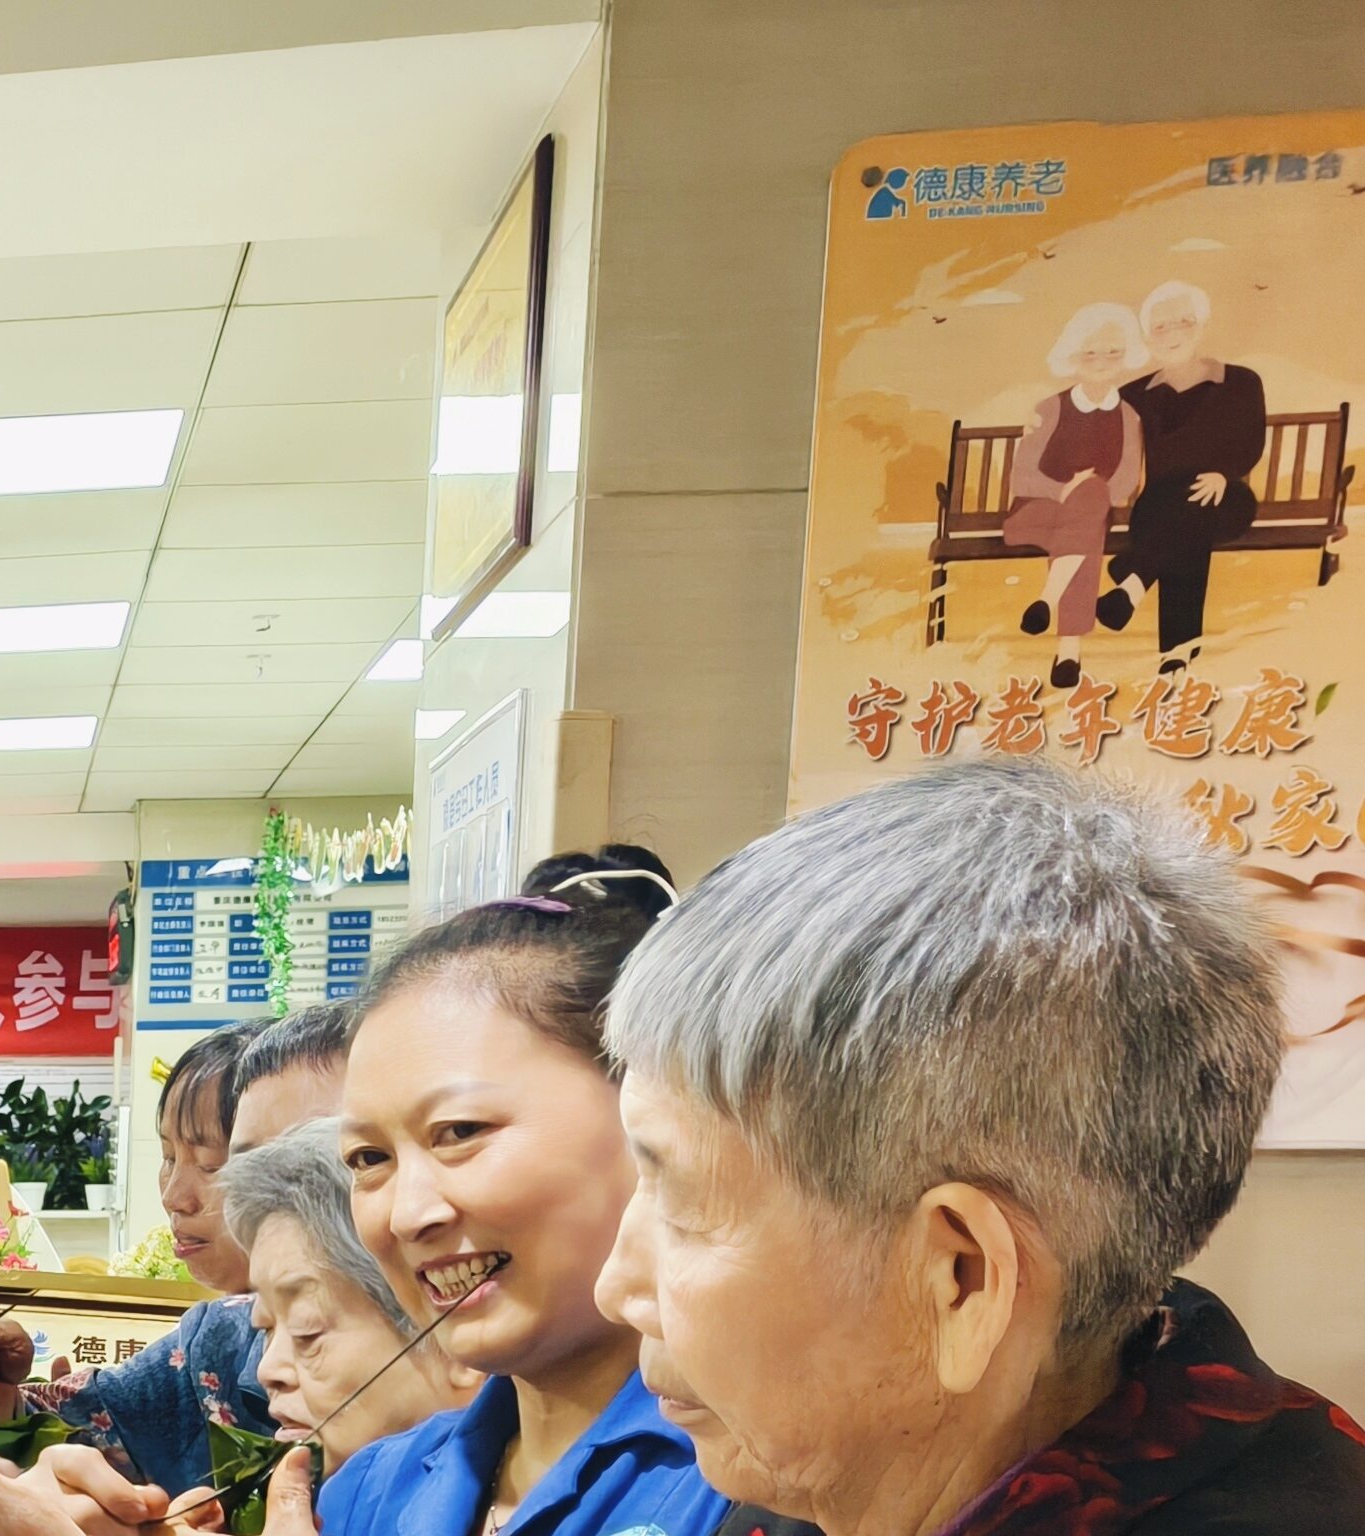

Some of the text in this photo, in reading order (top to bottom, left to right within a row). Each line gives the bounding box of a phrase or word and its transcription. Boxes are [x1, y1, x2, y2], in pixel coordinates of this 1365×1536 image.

[912, 159, 1066, 202] 德康养老
[845, 669, 1314, 764] 守护老年健康
